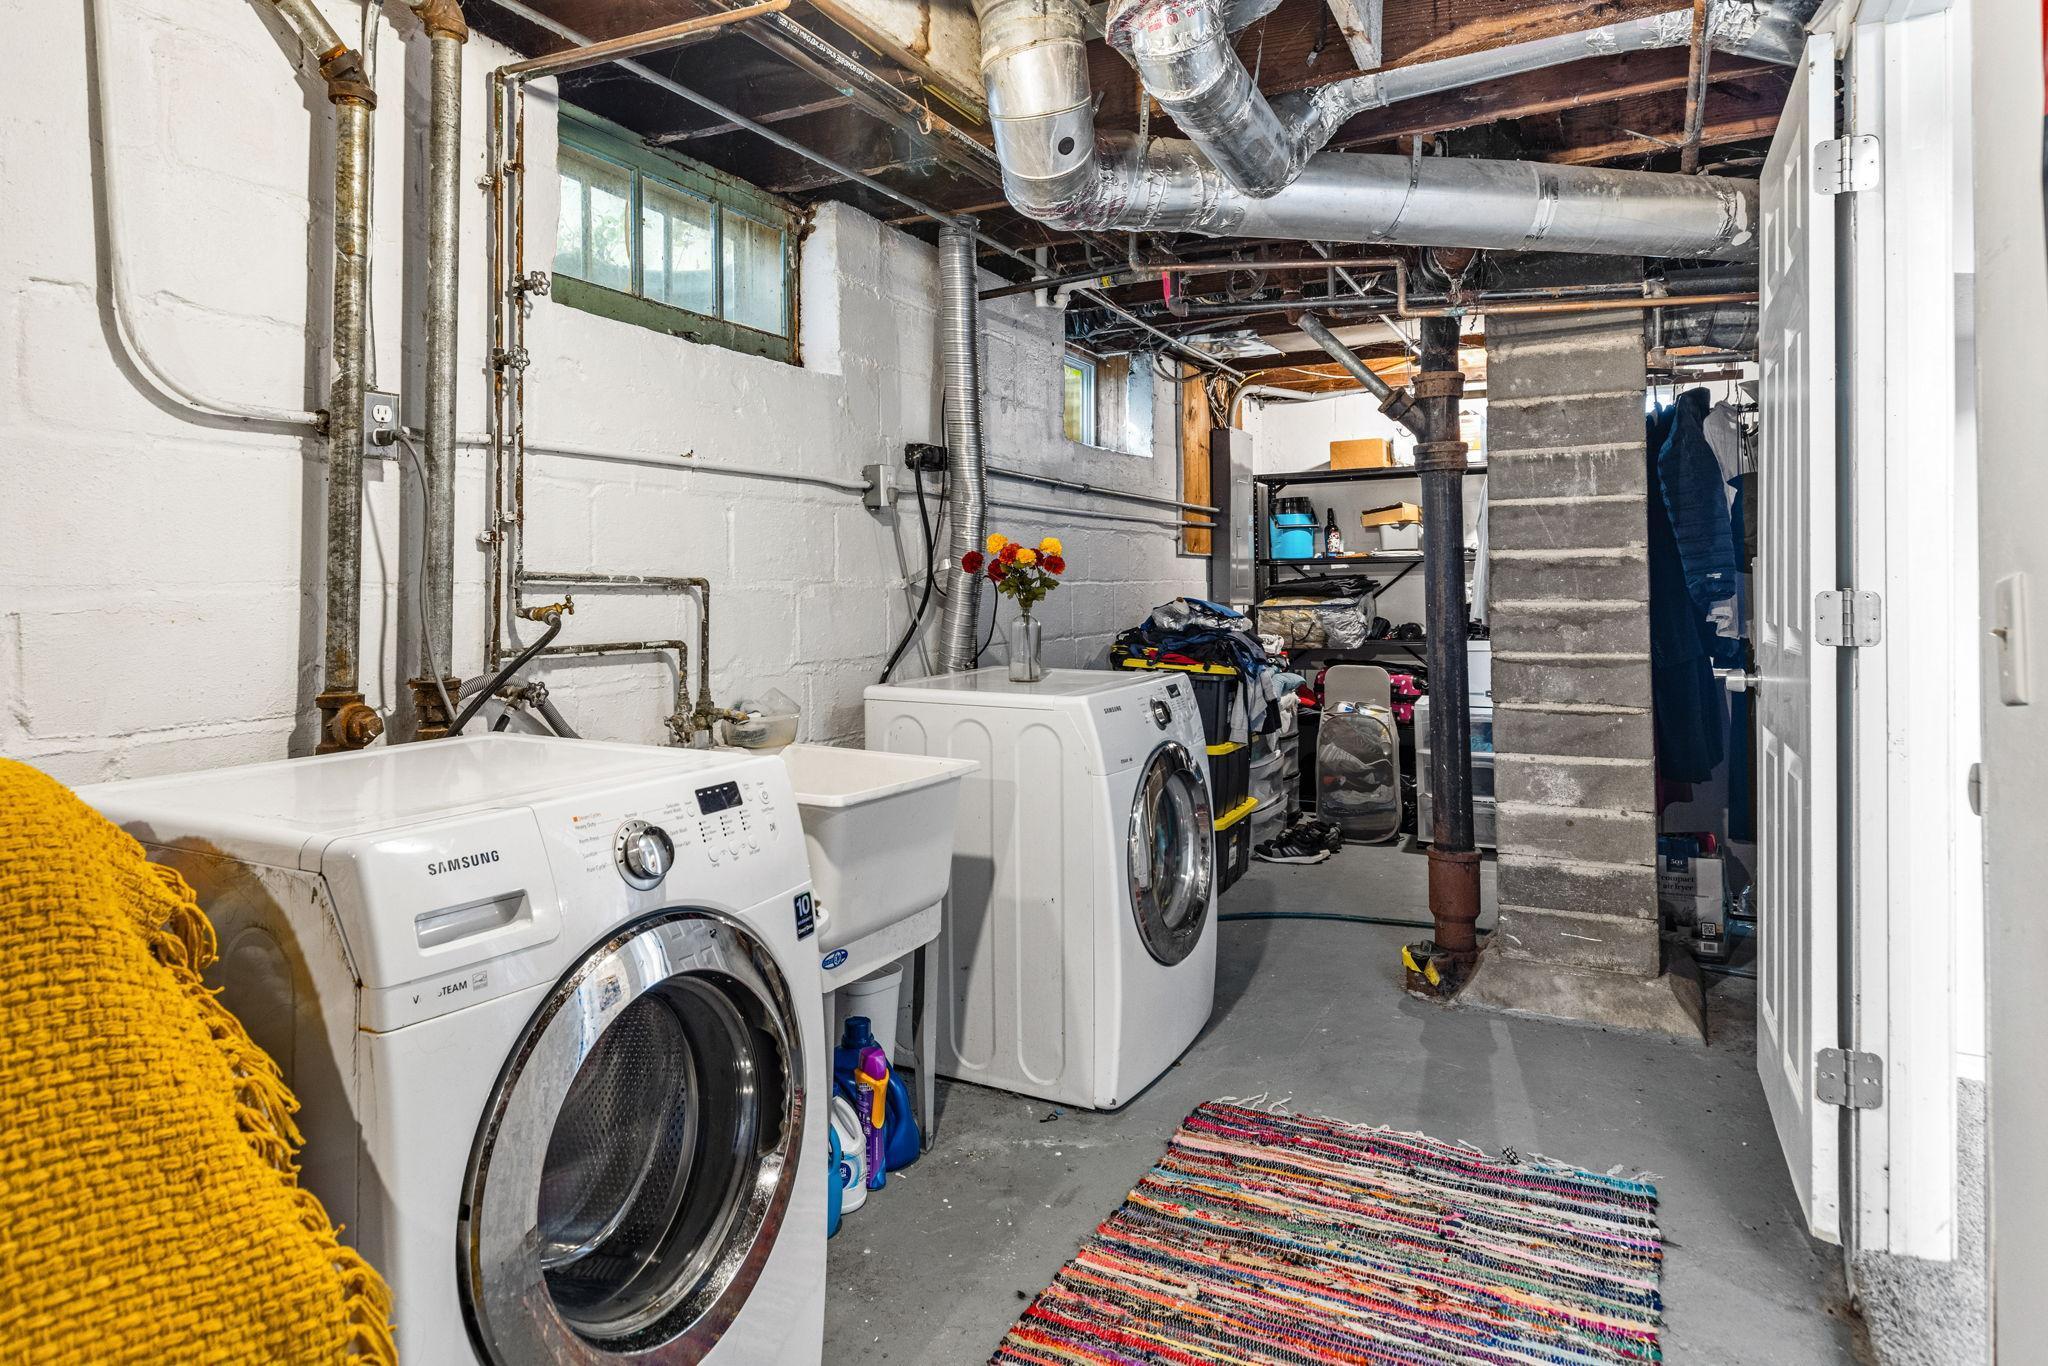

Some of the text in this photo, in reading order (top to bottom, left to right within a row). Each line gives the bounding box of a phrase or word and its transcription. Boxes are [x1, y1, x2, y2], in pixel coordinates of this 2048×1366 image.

[1104, 706, 1122, 714] SAMSUNG
[428, 850, 500, 876] SAMSUNG
[796, 895, 810, 917] 10
[438, 980, 468, 997] TEAM
